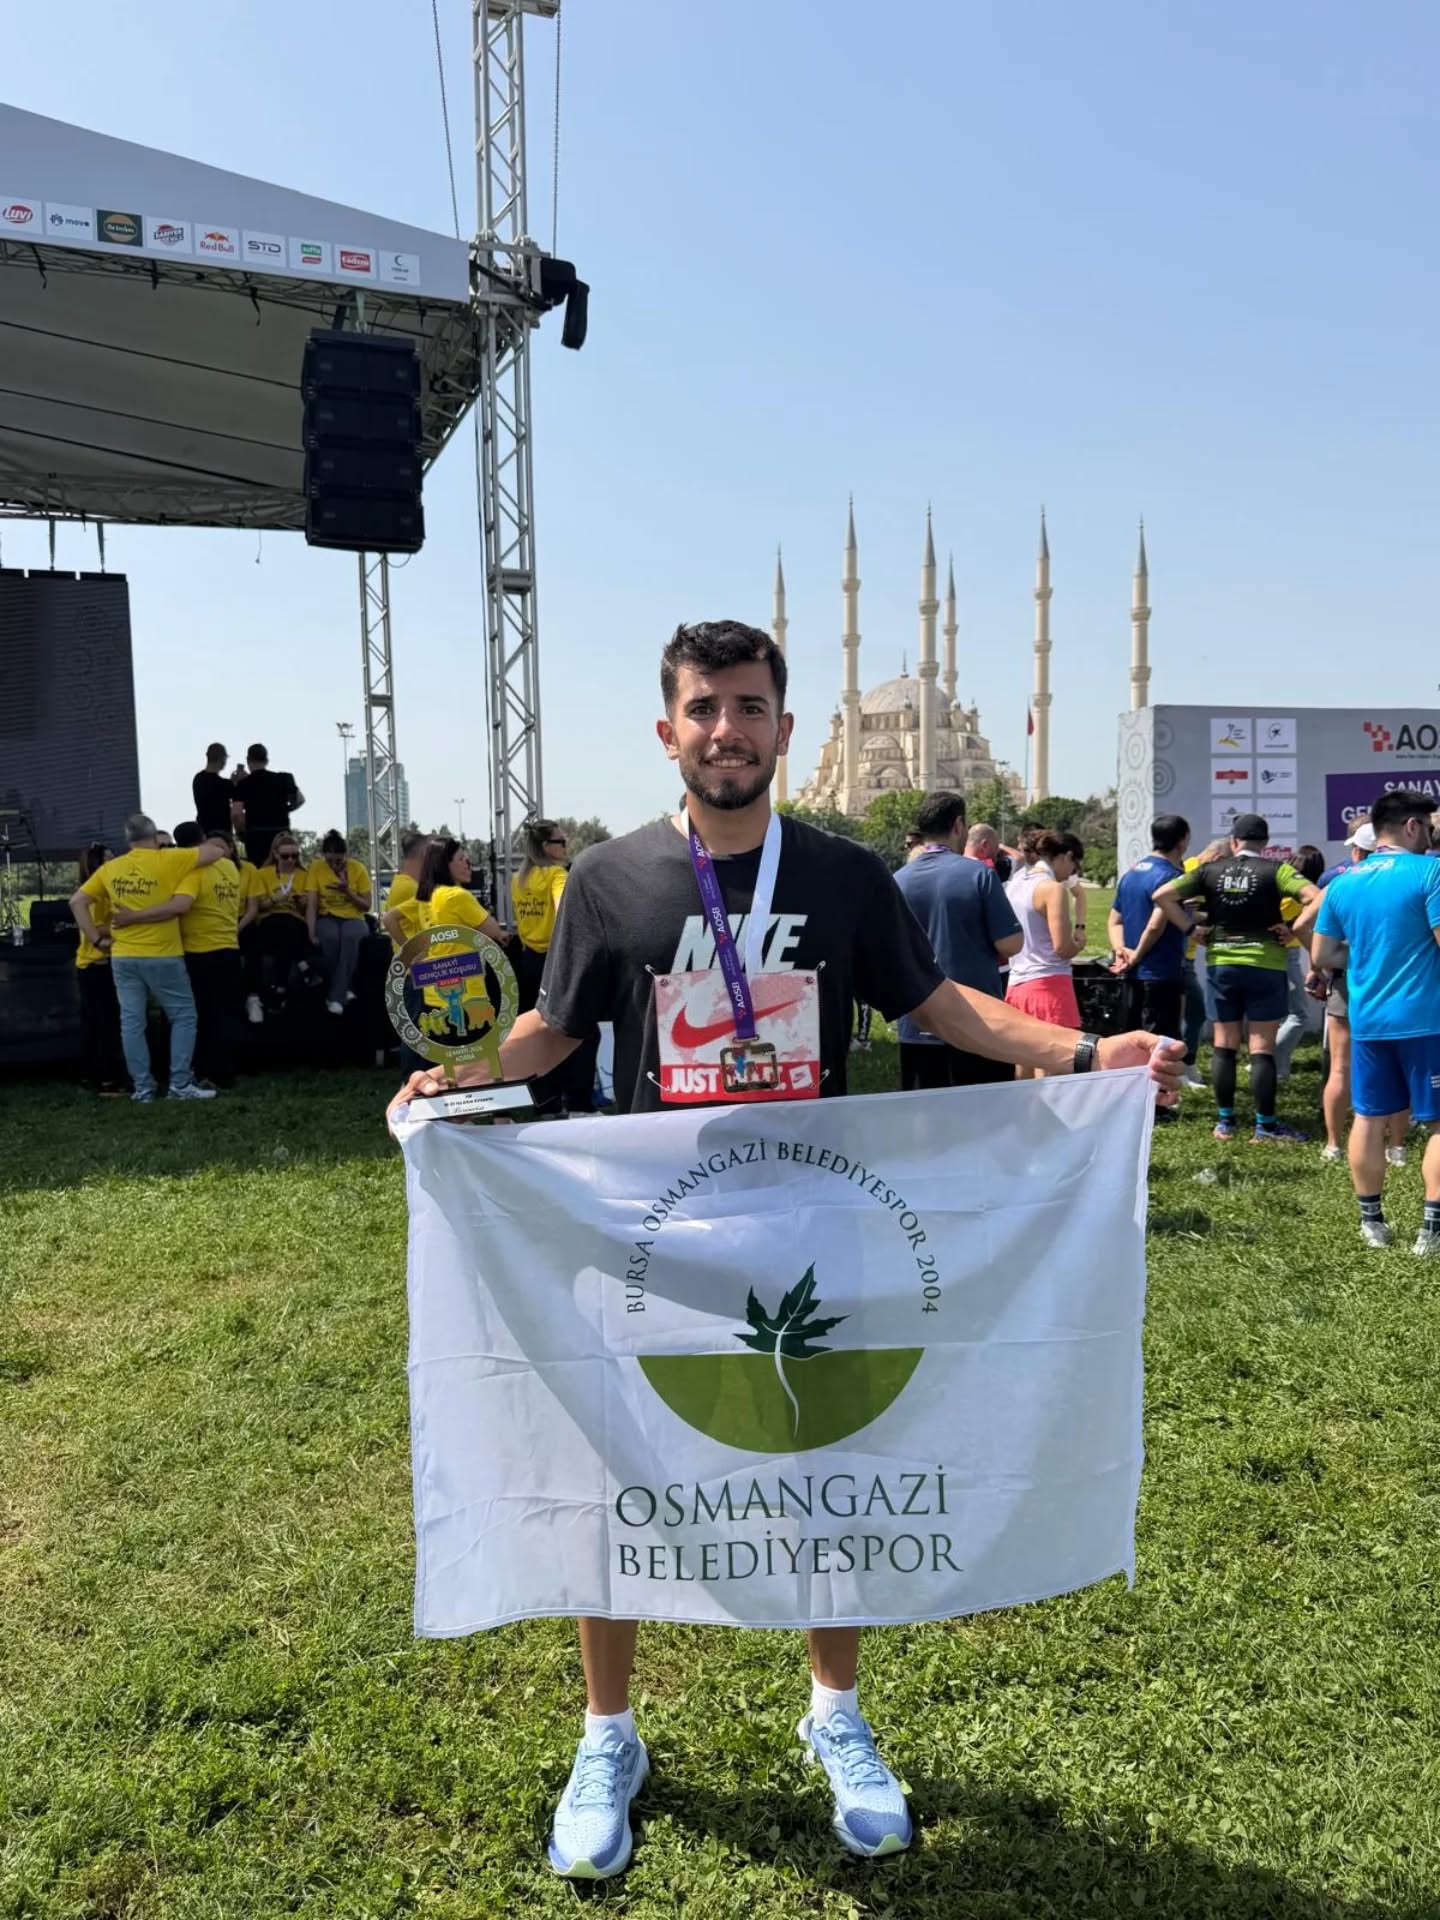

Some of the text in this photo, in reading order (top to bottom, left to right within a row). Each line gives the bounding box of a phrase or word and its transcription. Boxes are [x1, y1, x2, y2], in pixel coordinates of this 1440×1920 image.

[200, 241, 235, 253] Red Bull
[248, 240, 282, 253] STD
[1396, 724, 1440, 751] AO
[711, 907, 726, 933] AOSB
[430, 929, 460, 944] AOSB
[669, 913, 809, 974] NIE
[731, 981, 746, 1008] AOSB
[671, 1067, 720, 1093] JUST
[626, 1137, 942, 1315] BURSA OSMANGAZİ BELEDİYESPOR 2004
[615, 1464, 951, 1527] OSMANGAZİ
[617, 1529, 964, 1581] BELEDİYESPOR
